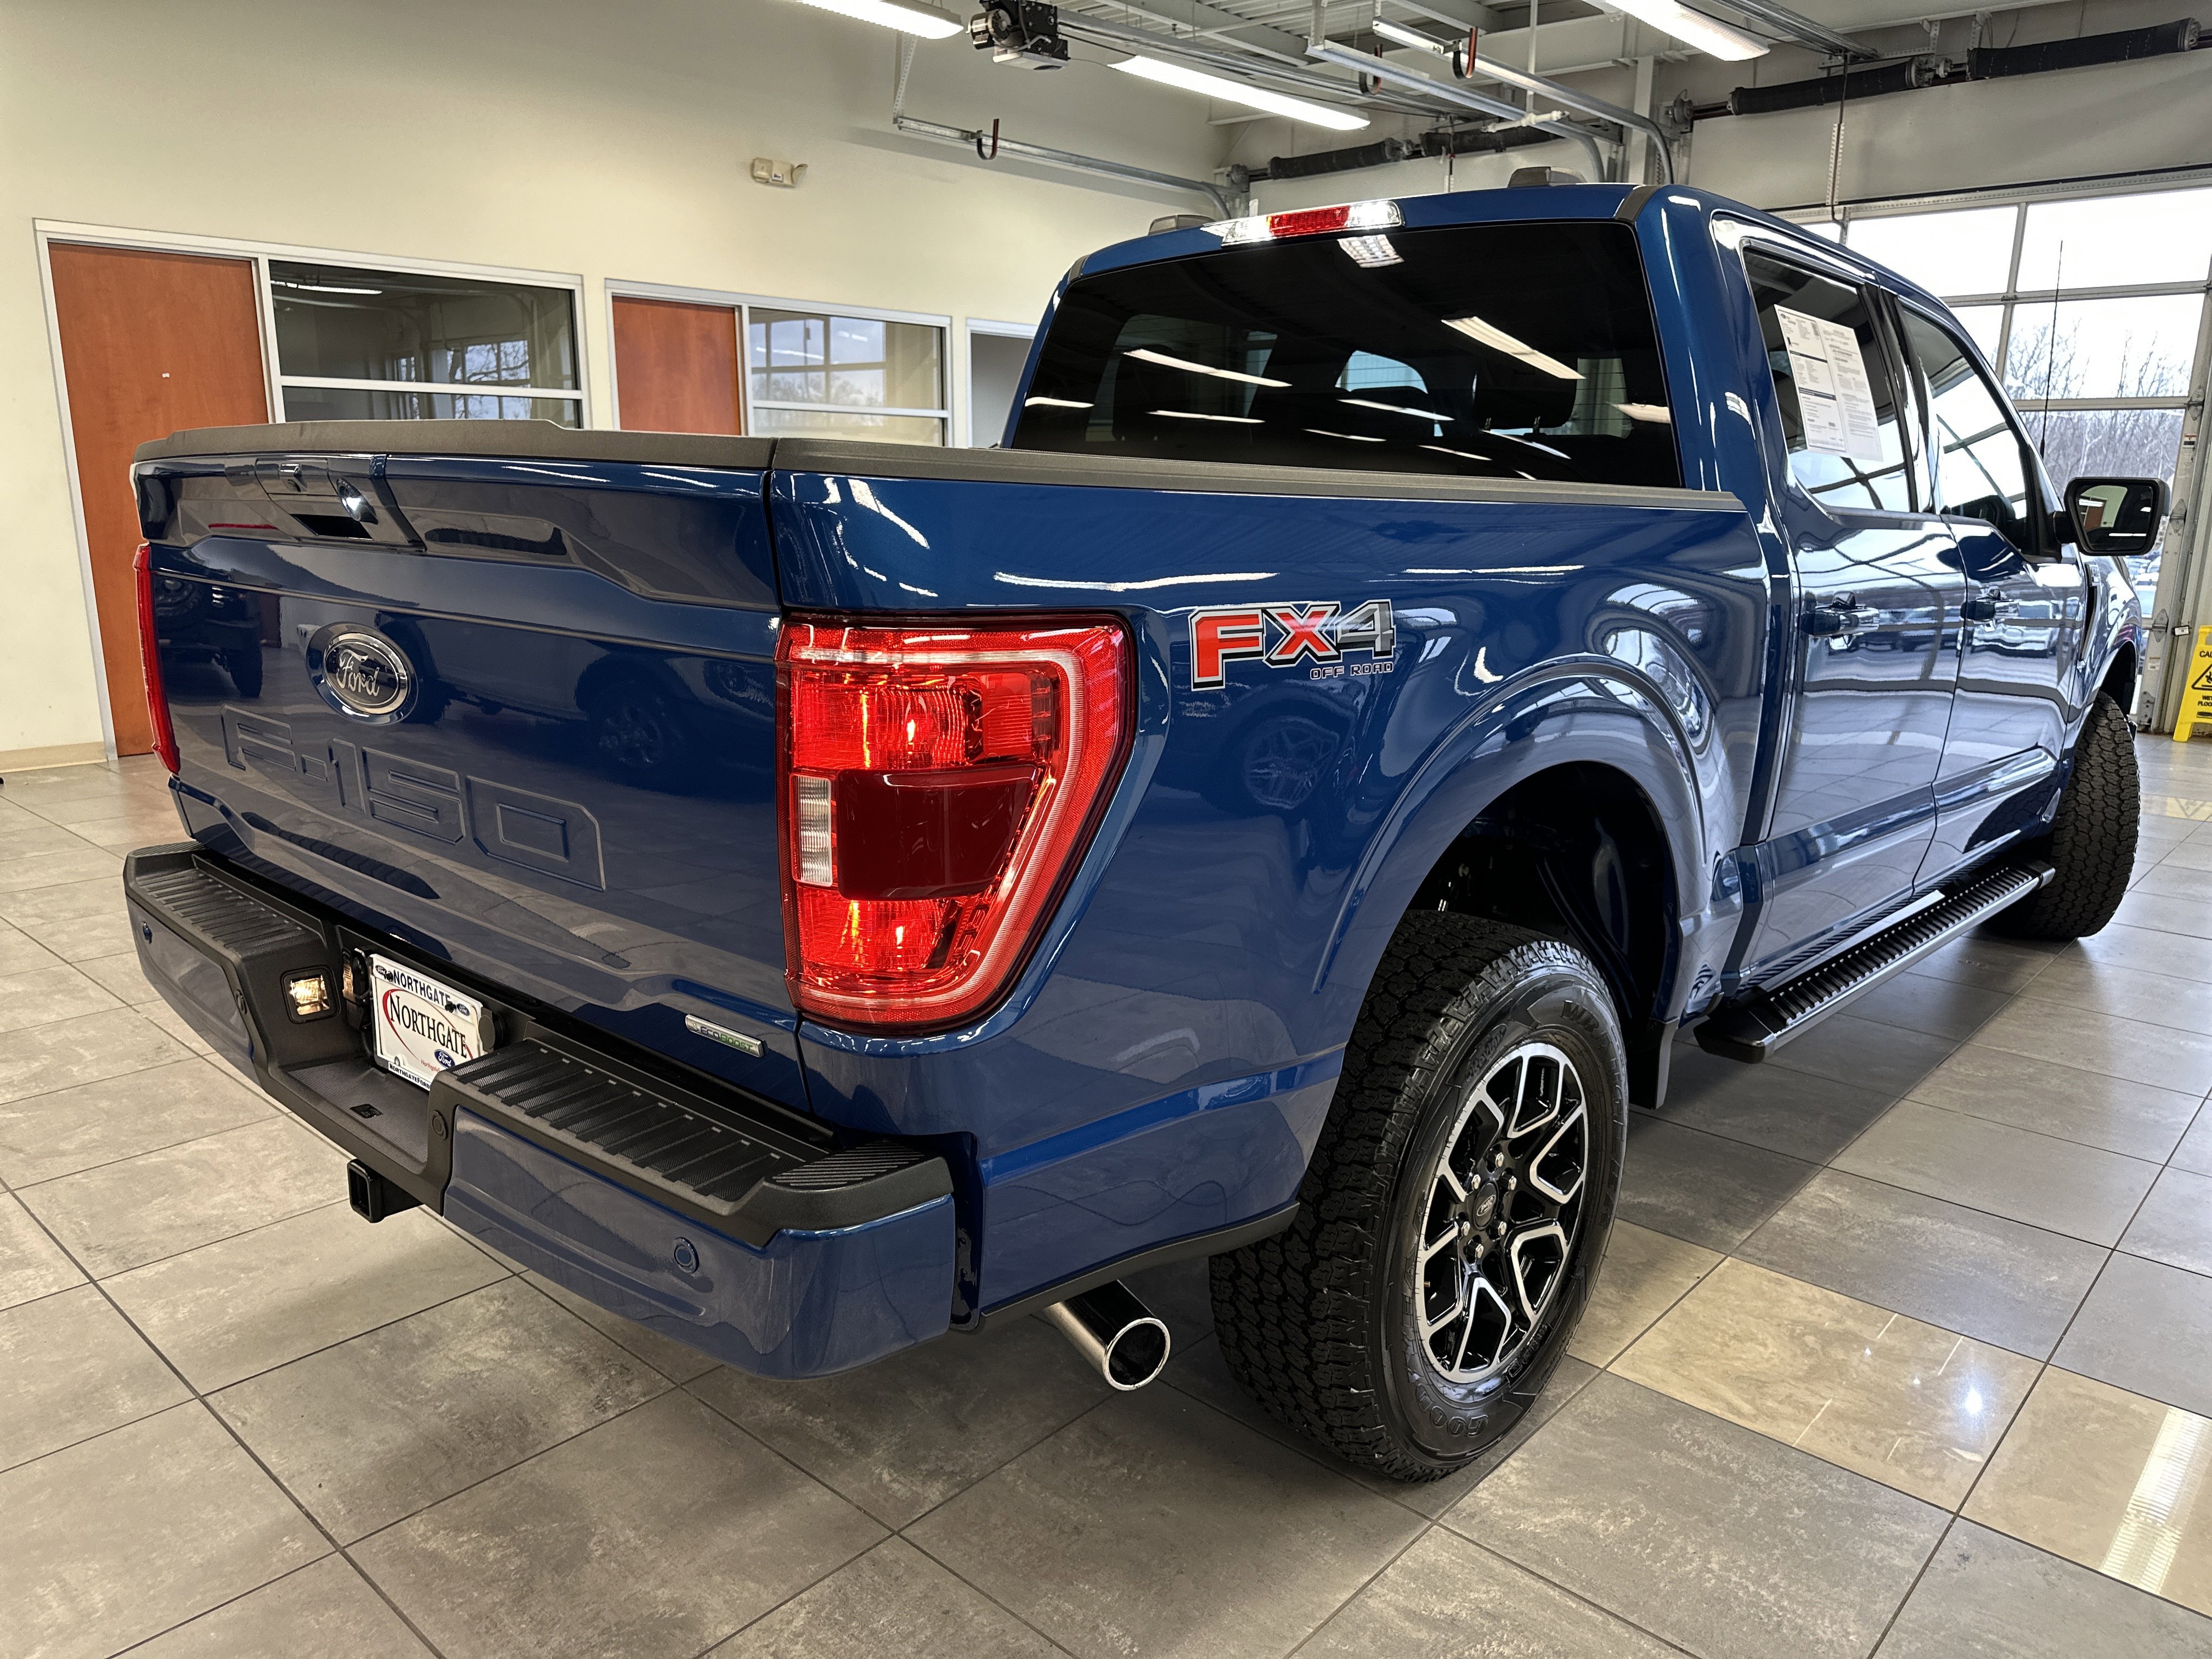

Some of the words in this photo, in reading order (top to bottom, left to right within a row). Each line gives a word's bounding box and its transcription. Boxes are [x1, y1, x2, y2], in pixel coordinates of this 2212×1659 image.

[1188, 599, 1396, 691] FX4
[336, 648, 380, 697] Ford
[1310, 665, 1345, 681] OFF
[1350, 661, 1395, 677] ROAD
[389, 991, 467, 1059] NORTHGATE
[438, 1051, 452, 1067] Ford
